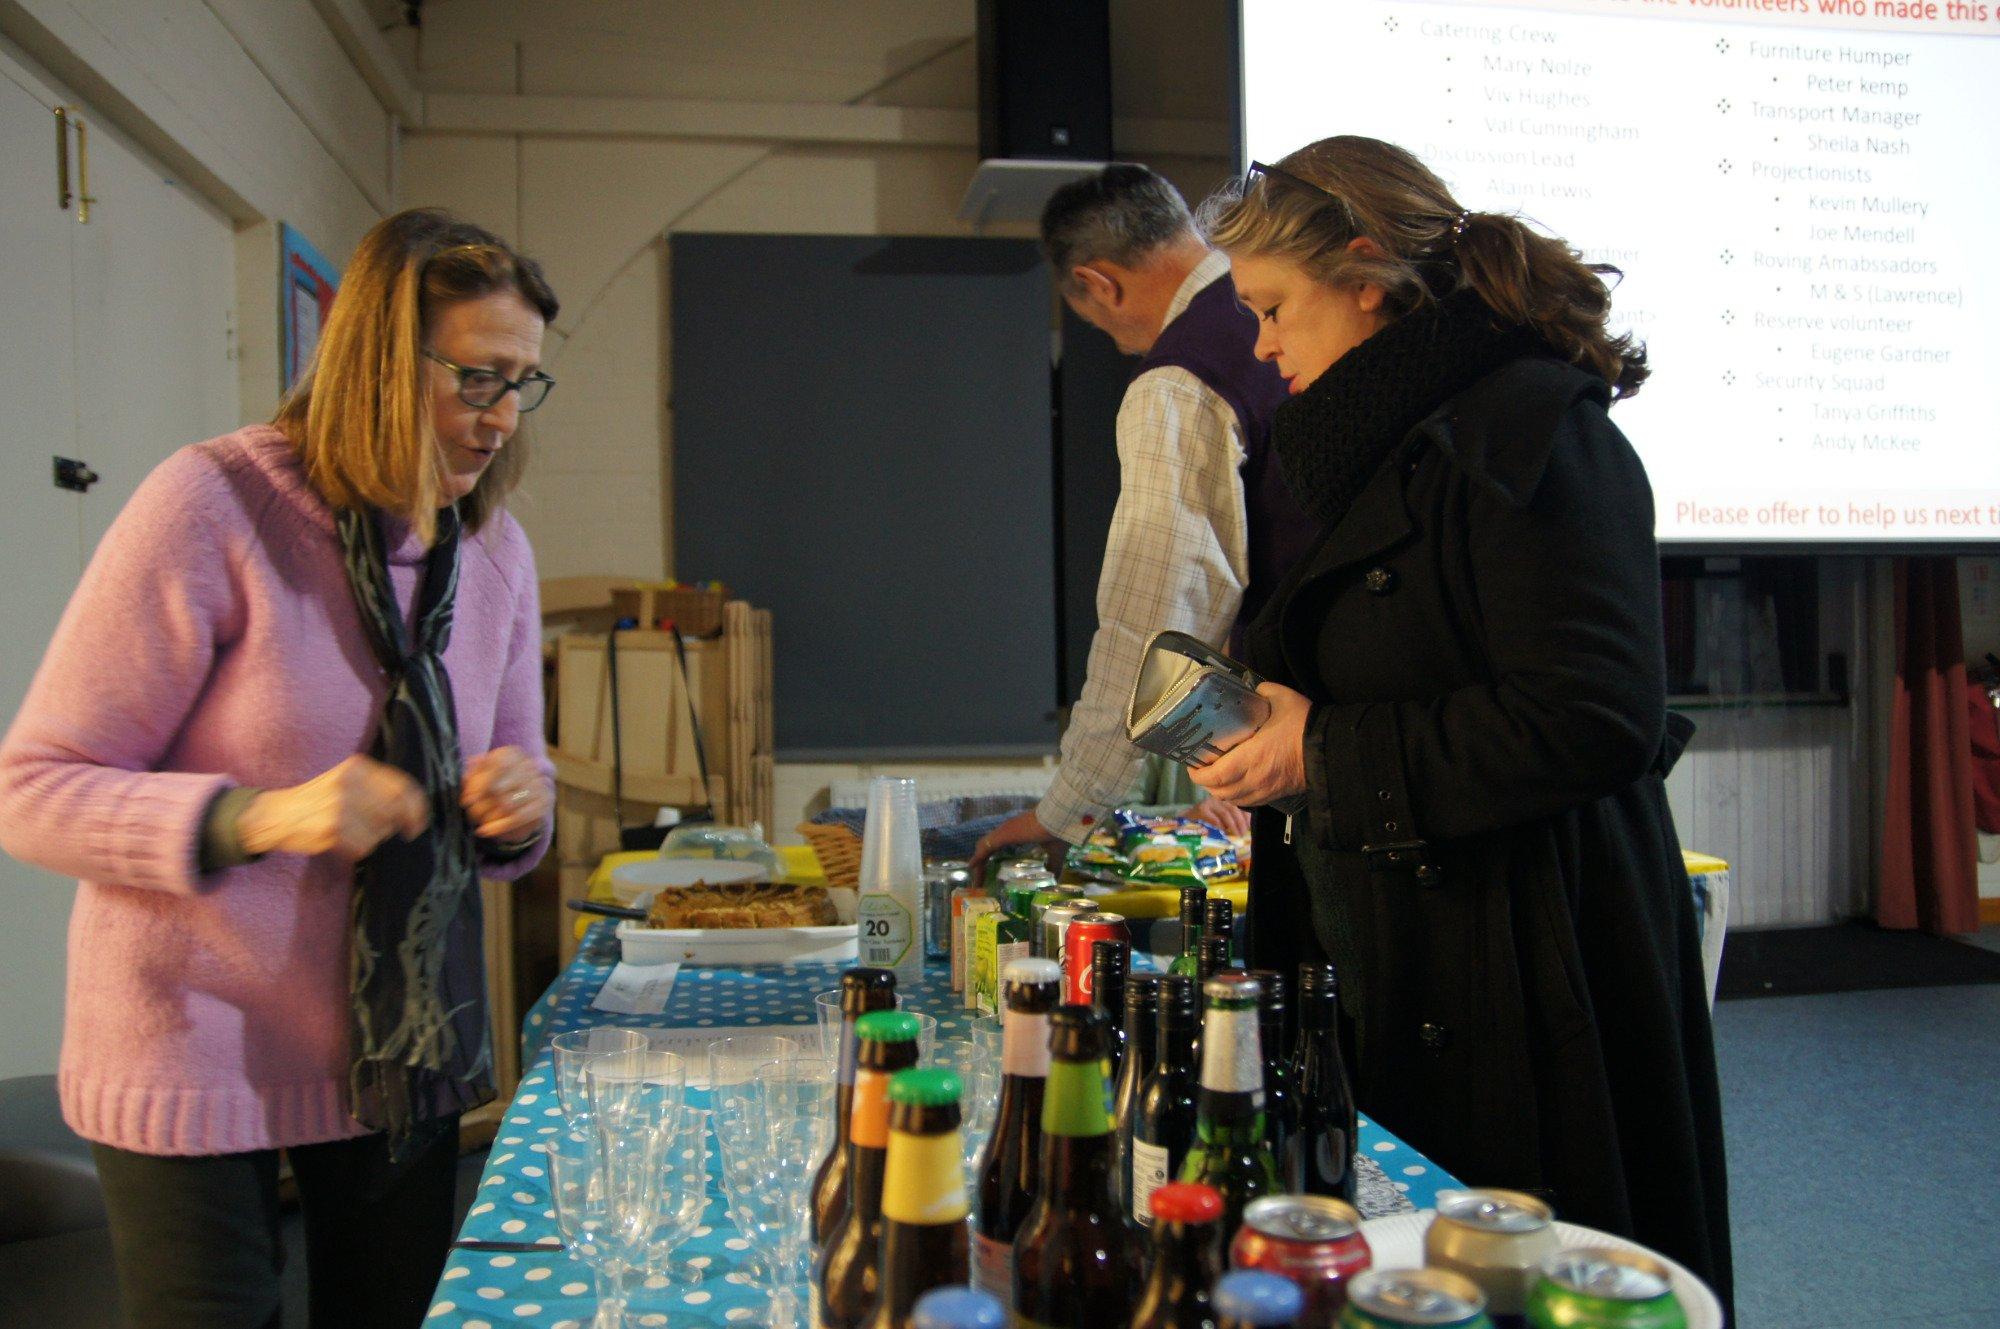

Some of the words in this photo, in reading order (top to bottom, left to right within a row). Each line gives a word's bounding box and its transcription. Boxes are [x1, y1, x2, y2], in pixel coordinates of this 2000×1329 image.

[1817, 0, 1867, 16] who
[1874, 0, 1939, 20] made
[1946, 1, 1988, 22] this
[1420, 19, 1502, 47] Catering
[1509, 25, 1558, 44] Crew
[1483, 54, 1533, 78] Mary
[1749, 40, 1834, 63] Furniture
[1839, 46, 1913, 70] Humper
[1807, 73, 1854, 93] Peter
[1859, 75, 1910, 100] kemp
[1519, 89, 1590, 110] Hughes
[1752, 101, 1835, 124] Transport
[1841, 105, 1922, 131] Manager
[1485, 118, 1513, 133] Val
[1520, 118, 1639, 144] Cunningham
[1424, 143, 1527, 164] Discussion
[1532, 151, 1575, 168] Lead
[1808, 133, 1860, 153] Sheila
[1865, 136, 1911, 156] Nash
[1752, 160, 1872, 183] Projectionists
[1487, 179, 1534, 195] Alain
[1542, 183, 1591, 199] Lewis
[1808, 194, 1856, 211] Kevin
[1862, 196, 1931, 221] Mullery
[1809, 224, 1840, 241] Joe
[1843, 224, 1915, 244] Mendell
[1753, 251, 1813, 274] Roving
[1818, 254, 1938, 275] Amabssadors
[1810, 283, 1829, 300] M
[1832, 284, 1849, 301] &
[1852, 285, 1864, 302] S
[1868, 285, 1963, 309] (Lawrence)
[1755, 312, 1824, 330] Reserve
[1830, 315, 1913, 333] volunteer
[1811, 342, 1875, 366] Eugene
[1880, 345, 1952, 363] Gardner
[1756, 372, 1826, 392] Security
[1832, 374, 1885, 394] Squad
[1812, 403, 1863, 423] Tanya
[1866, 404, 1936, 422] Griffiths
[1812, 433, 1856, 453] Andy
[1862, 434, 1921, 452] McKee
[1676, 503, 1749, 525] Please
[1757, 502, 1810, 525] offer
[1817, 505, 1841, 525] to
[1848, 503, 1896, 529] help
[1903, 507, 1928, 525] us
[1935, 505, 1982, 526] next
[1988, 504, 2000, 526] ti
[866, 919, 890, 937] 20
